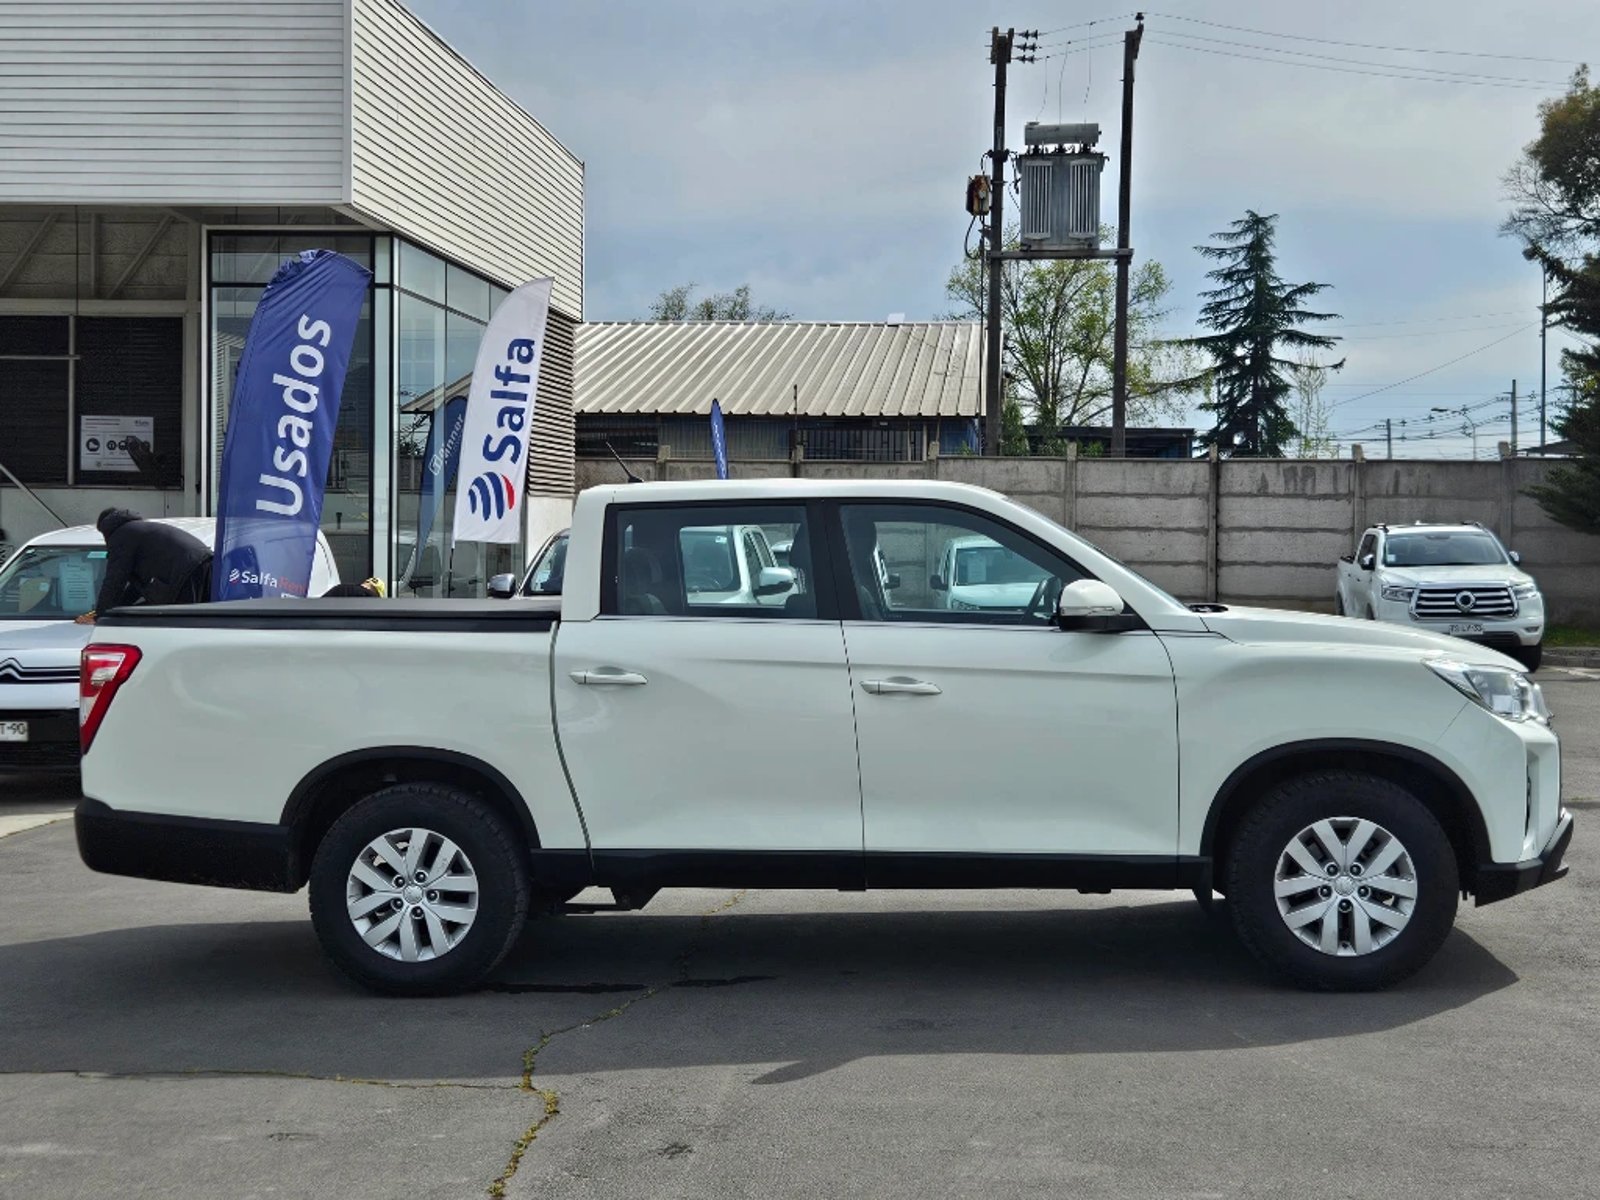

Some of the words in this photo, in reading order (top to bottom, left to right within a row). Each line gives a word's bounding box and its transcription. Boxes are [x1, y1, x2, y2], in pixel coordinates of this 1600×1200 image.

[256, 314, 331, 516] Usados
[483, 338, 535, 464] Salfa
[241, 571, 278, 588] Salfa
